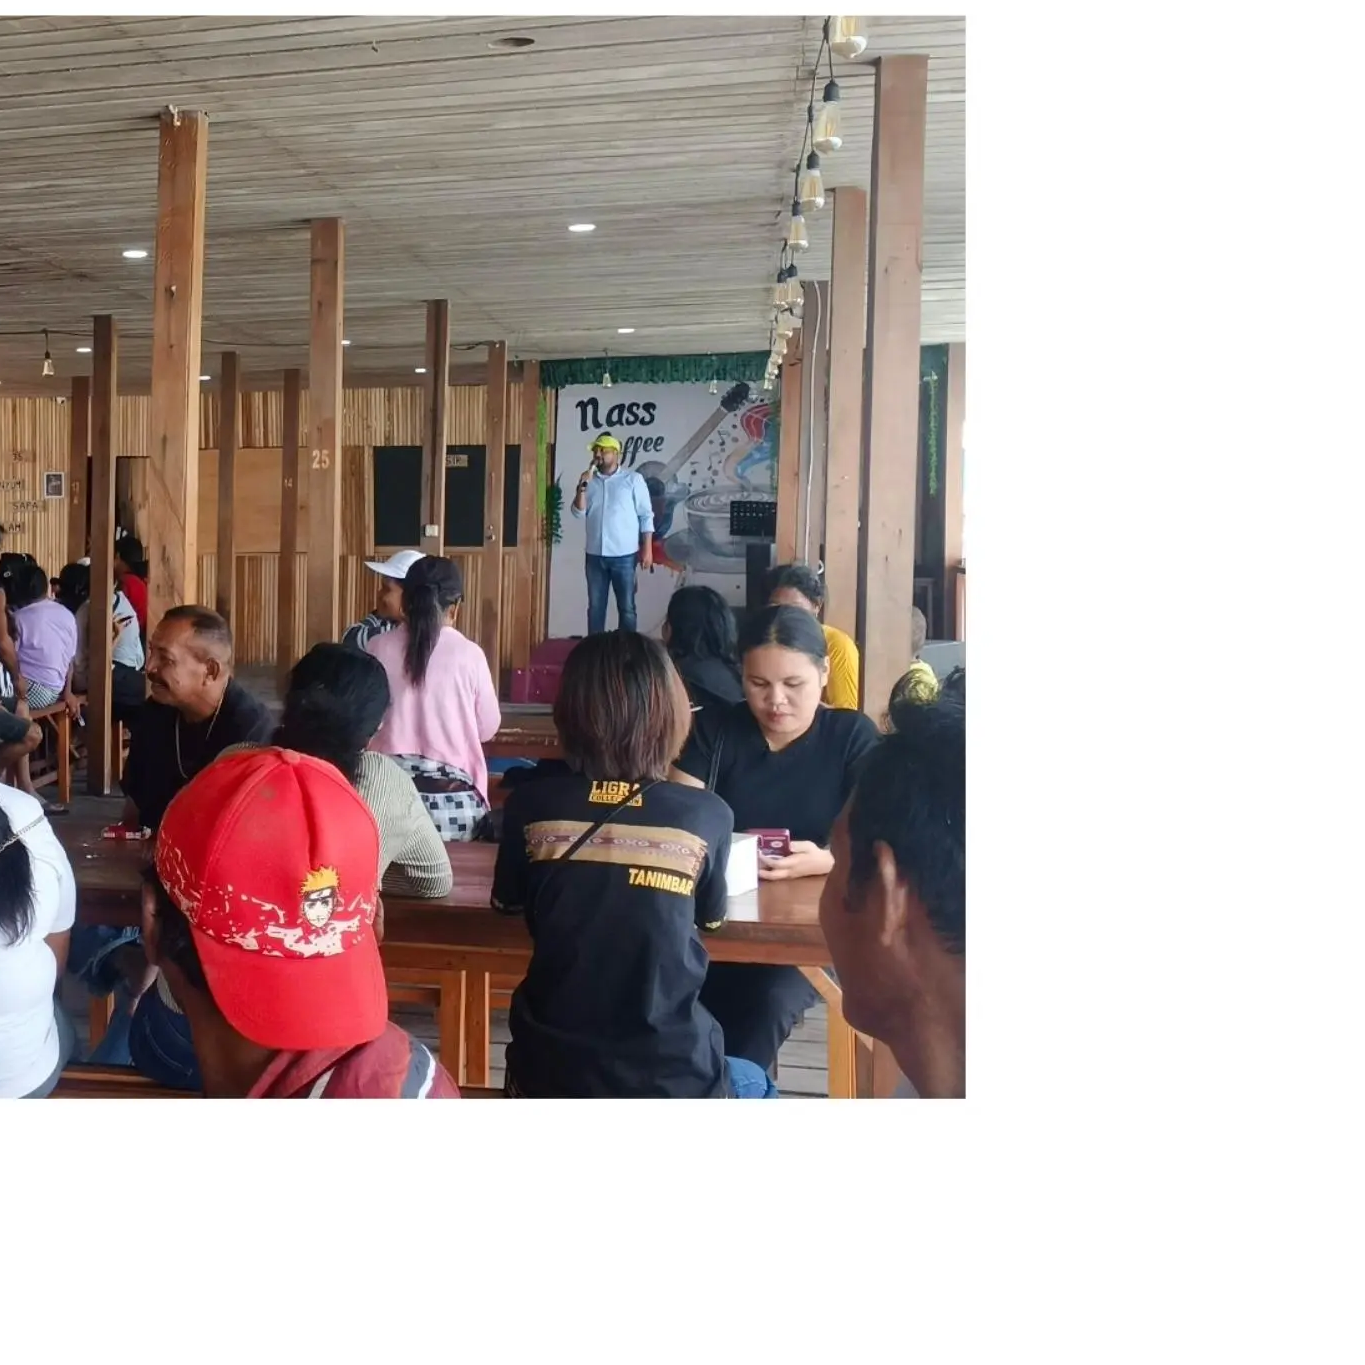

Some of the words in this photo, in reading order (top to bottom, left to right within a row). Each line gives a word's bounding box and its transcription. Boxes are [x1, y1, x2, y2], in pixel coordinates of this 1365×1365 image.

[311, 449, 330, 469] 25
[12, 501, 39, 511] SAPA
[629, 868, 693, 895] TANIMBAR
